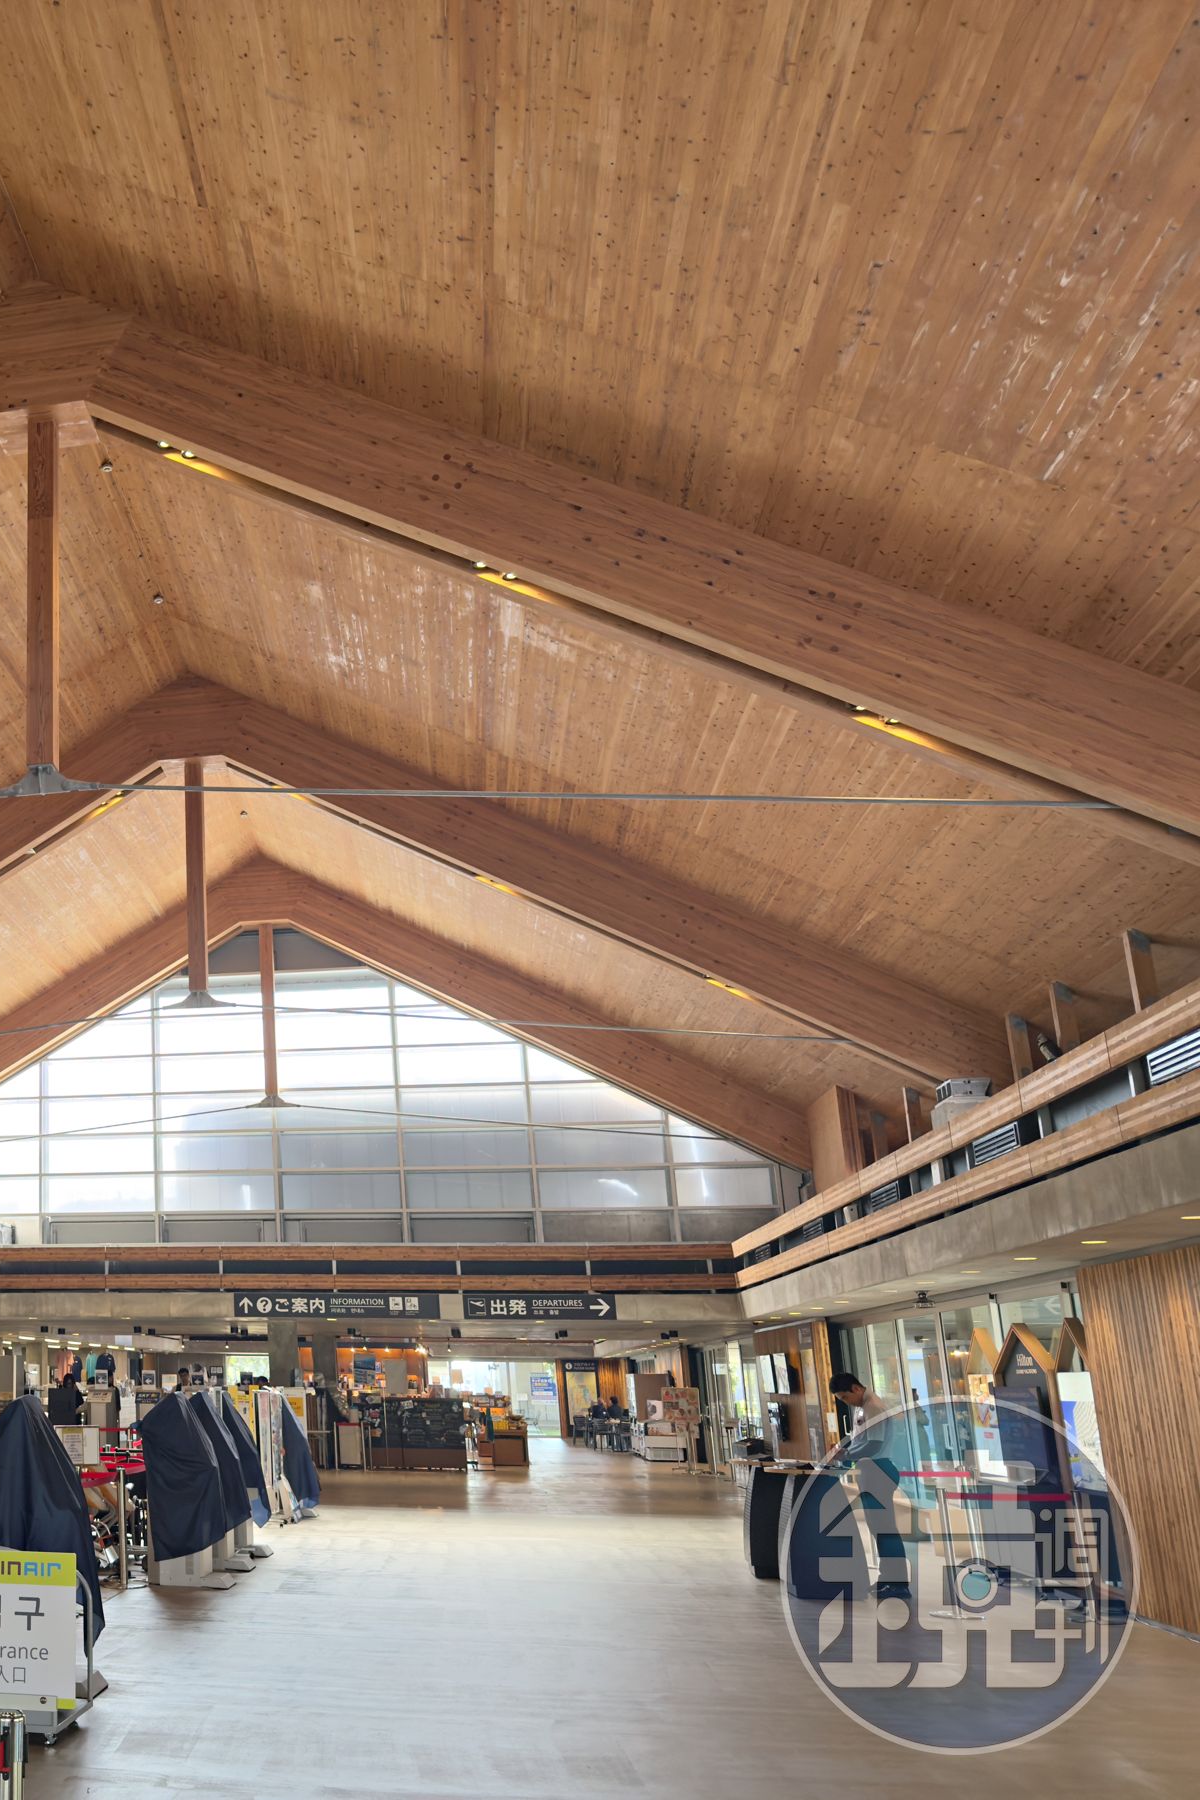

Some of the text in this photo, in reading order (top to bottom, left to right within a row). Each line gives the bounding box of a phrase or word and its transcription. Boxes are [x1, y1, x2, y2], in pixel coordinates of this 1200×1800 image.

[275, 1298, 326, 1314] ご案内
[330, 1298, 384, 1306] INFORMATION
[490, 1299, 527, 1315] 出発
[532, 1299, 583, 1307] DEPARTURES
[1016, 1354, 1033, 1366] Hilton
